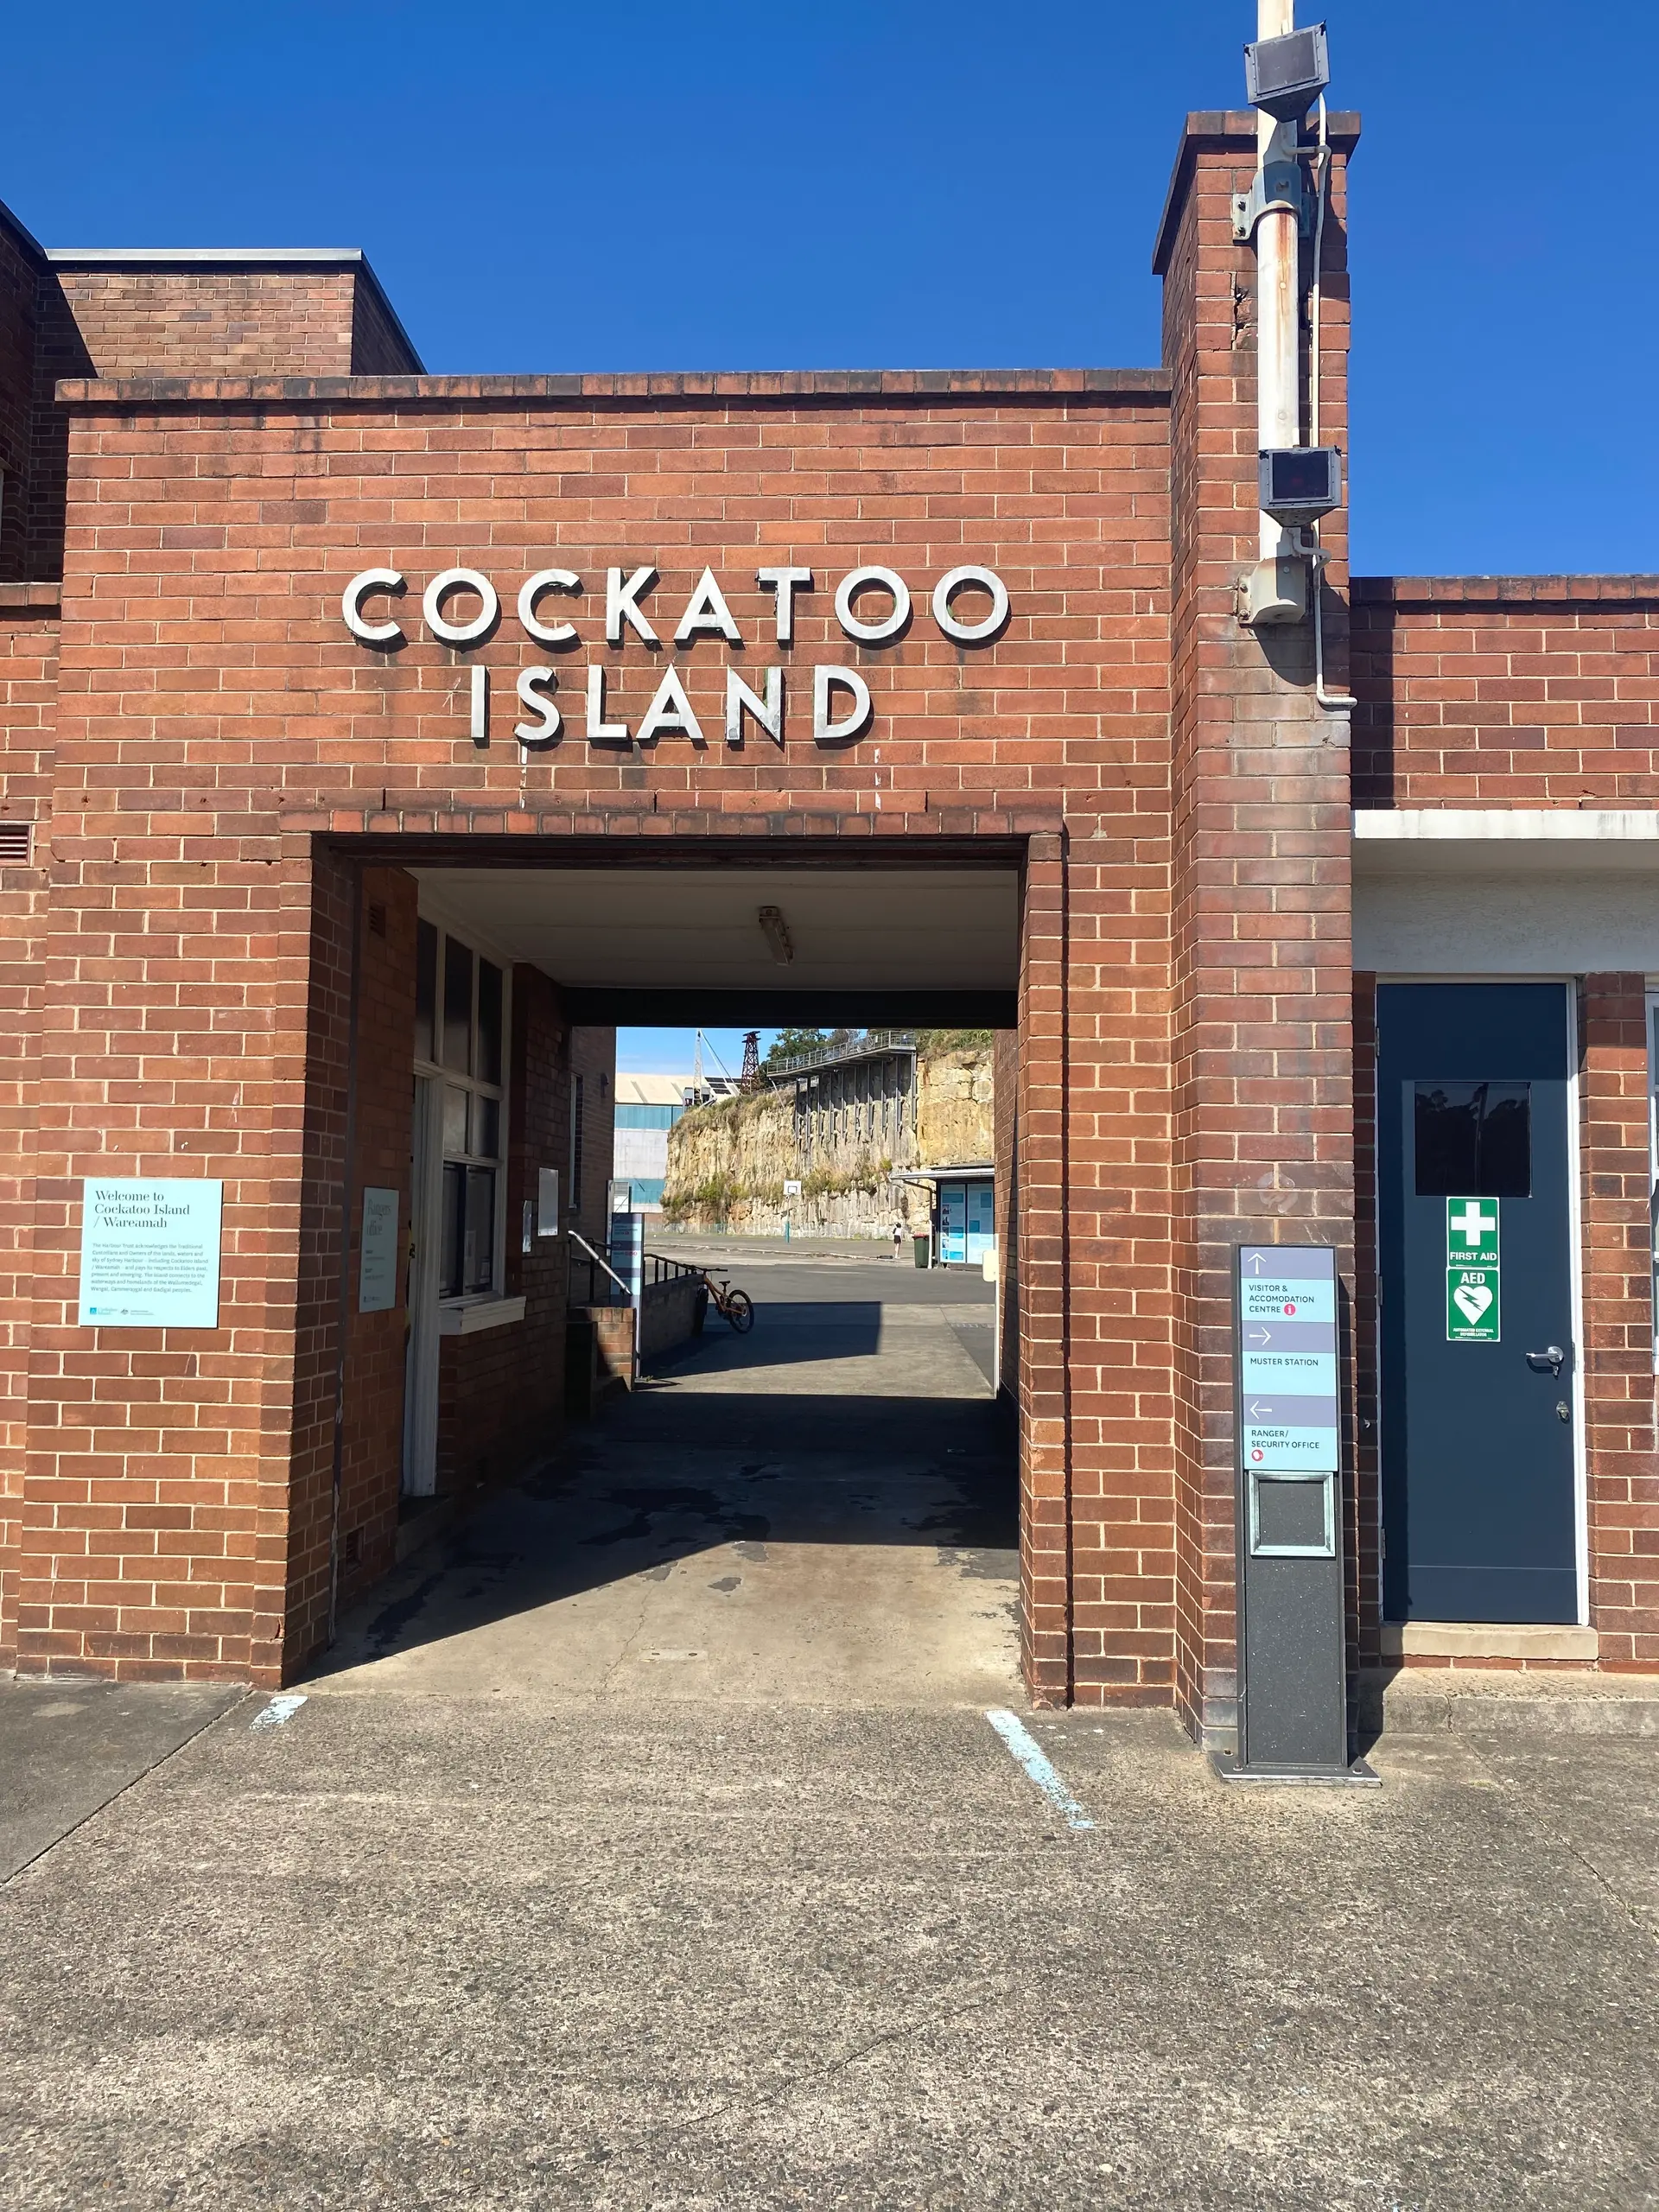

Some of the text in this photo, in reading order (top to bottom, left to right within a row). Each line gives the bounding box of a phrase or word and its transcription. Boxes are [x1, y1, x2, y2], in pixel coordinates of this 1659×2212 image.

[342, 564, 1009, 642] COCKATOO
[470, 664, 871, 743] ISLAND
[95, 1190, 164, 1201] Welcome to
[94, 1203, 190, 1215] Cockatoo Island
[104, 1217, 168, 1228] Wareamah
[1450, 1252, 1497, 1261] FIRST AID
[1460, 1272, 1485, 1284] AED
